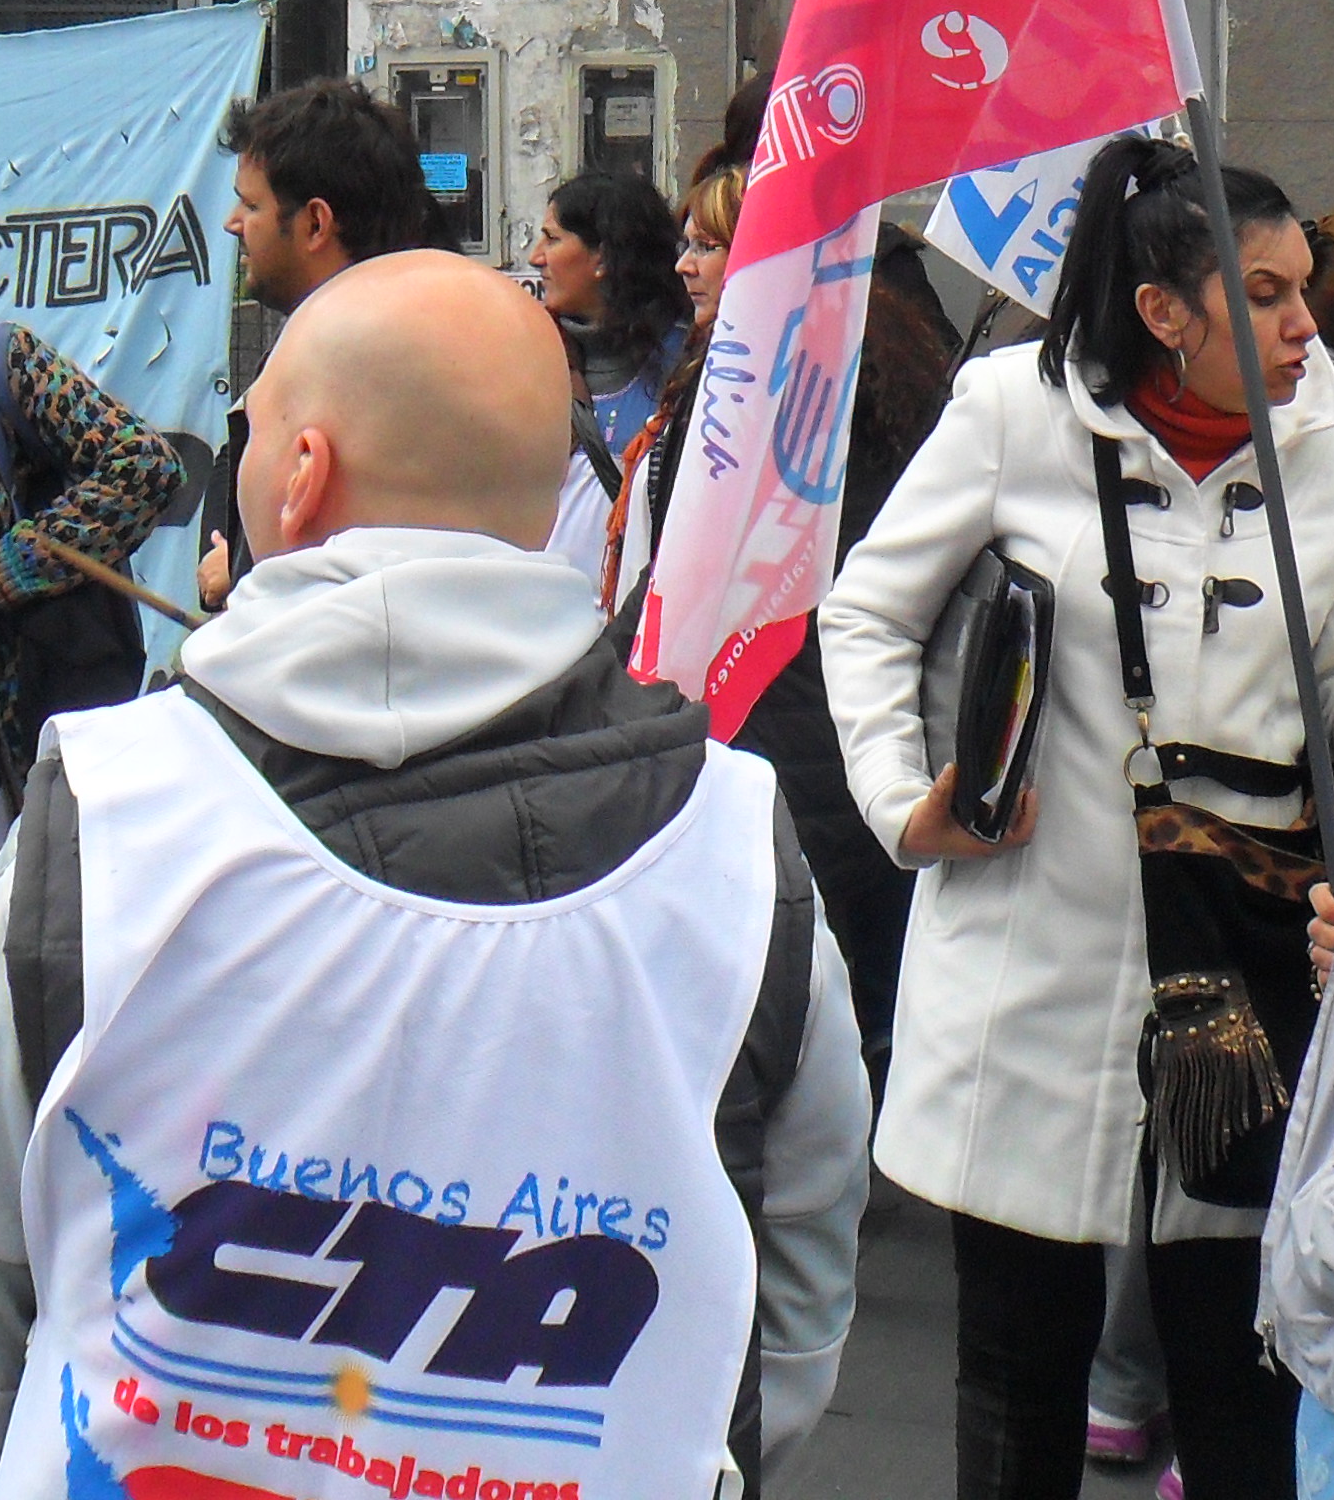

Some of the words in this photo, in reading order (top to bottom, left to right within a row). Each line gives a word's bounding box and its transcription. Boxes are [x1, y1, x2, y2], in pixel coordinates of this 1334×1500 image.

[199, 1120, 471, 1227] Buenos
[496, 1172, 671, 1251] Aires
[144, 1180, 661, 1389] CTA
[112, 1376, 161, 1426] de
[174, 1402, 251, 1448] los
[264, 1421, 581, 1500] trabajadores
